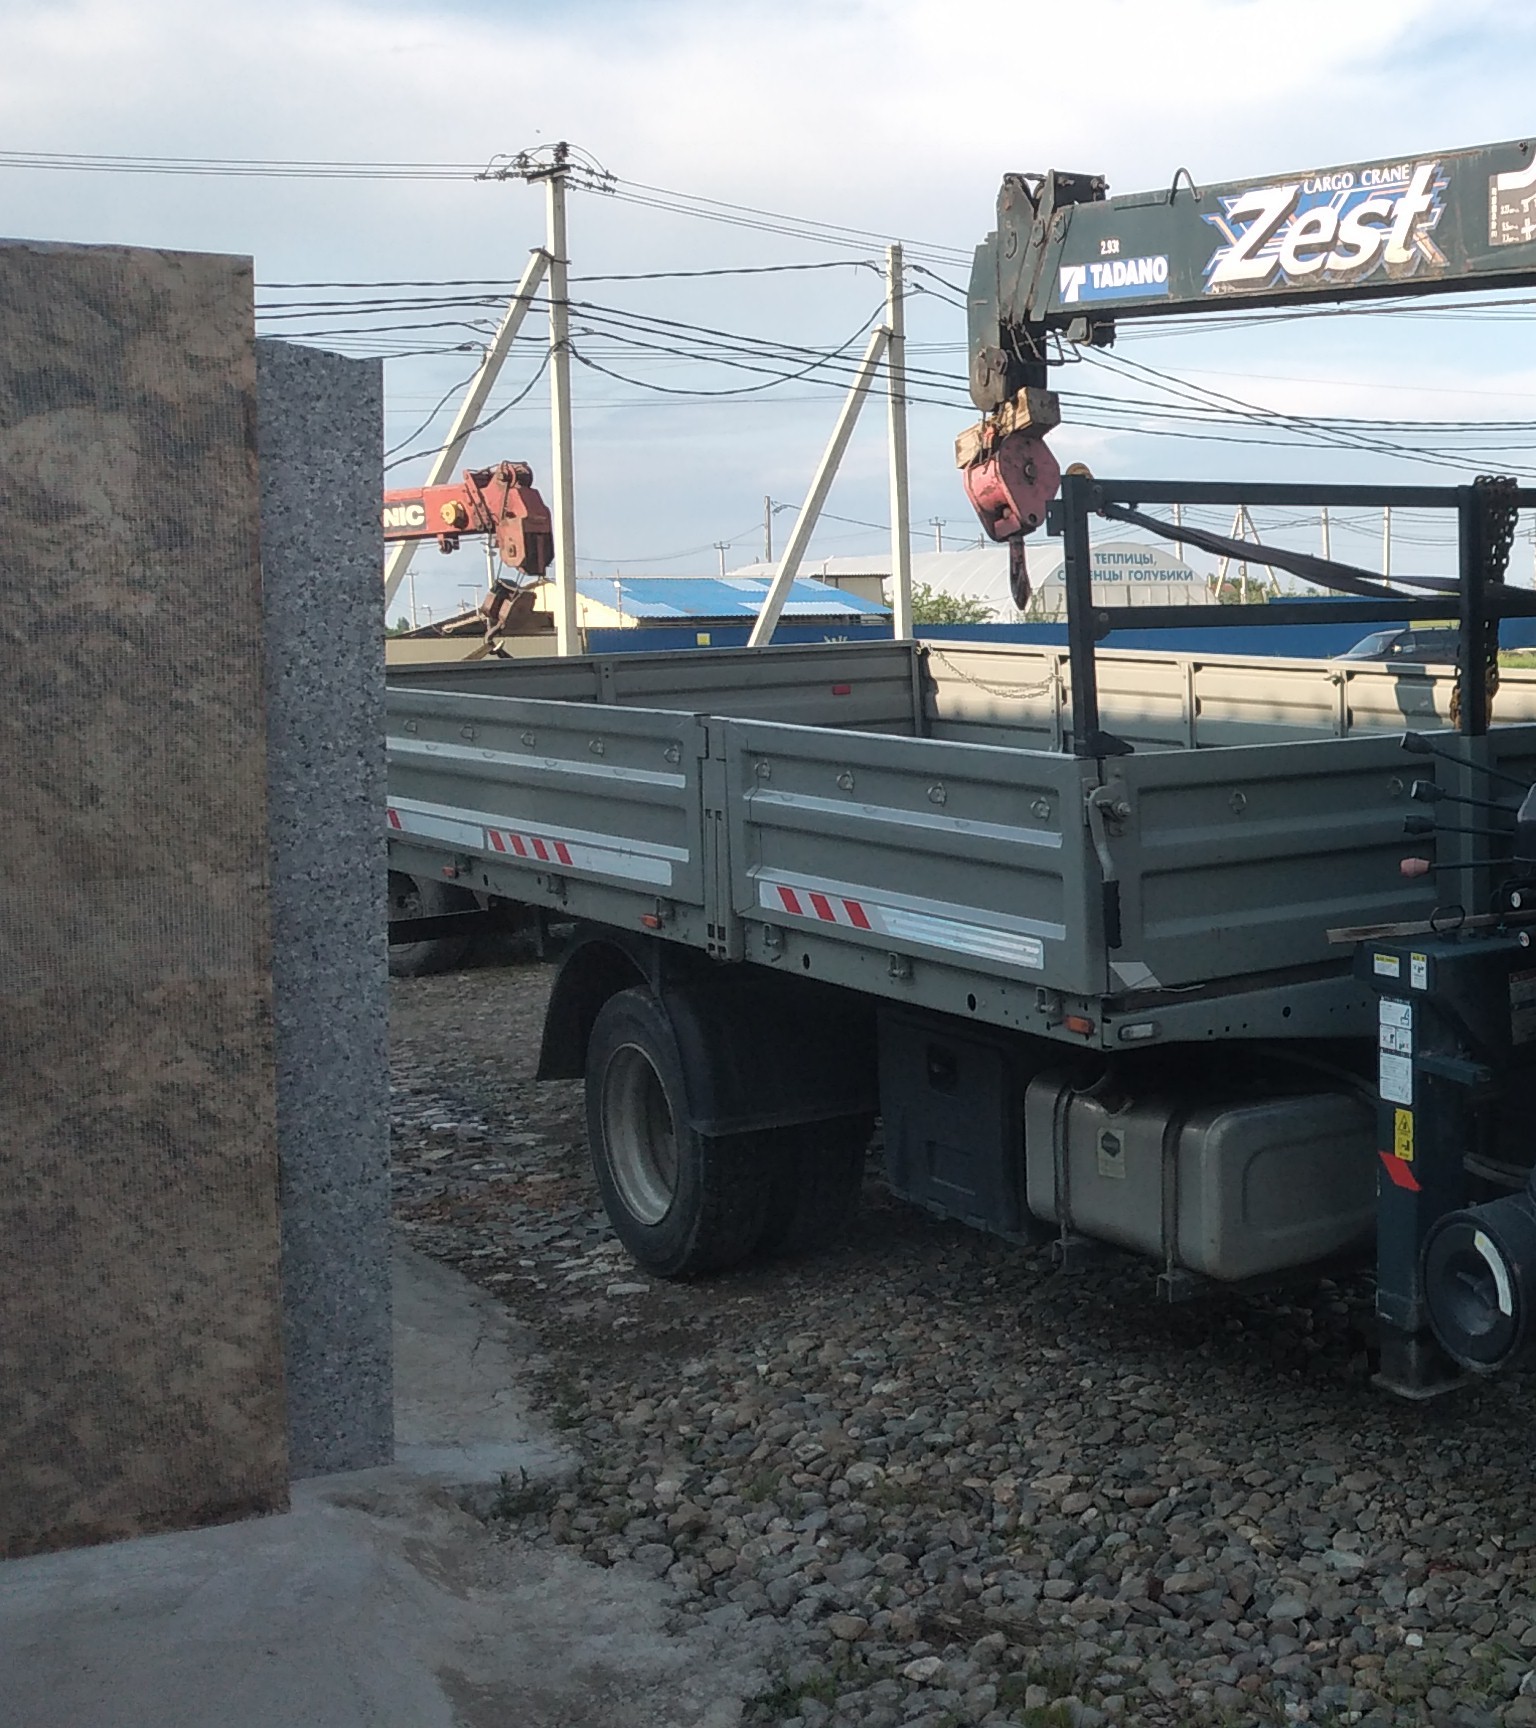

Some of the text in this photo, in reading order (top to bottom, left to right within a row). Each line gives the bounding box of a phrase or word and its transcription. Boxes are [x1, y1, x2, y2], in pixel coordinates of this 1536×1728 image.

[1303, 164, 1410, 195] CARGO CRANE
[1208, 163, 1437, 287] Zest
[1090, 256, 1168, 289] TADANO
[384, 504, 425, 528] NIC
[1094, 553, 1158, 566] ТЕПЛИЦЫ,
[1057, 569, 1194, 582] СНЦЫ ГОЛУБИКИ
